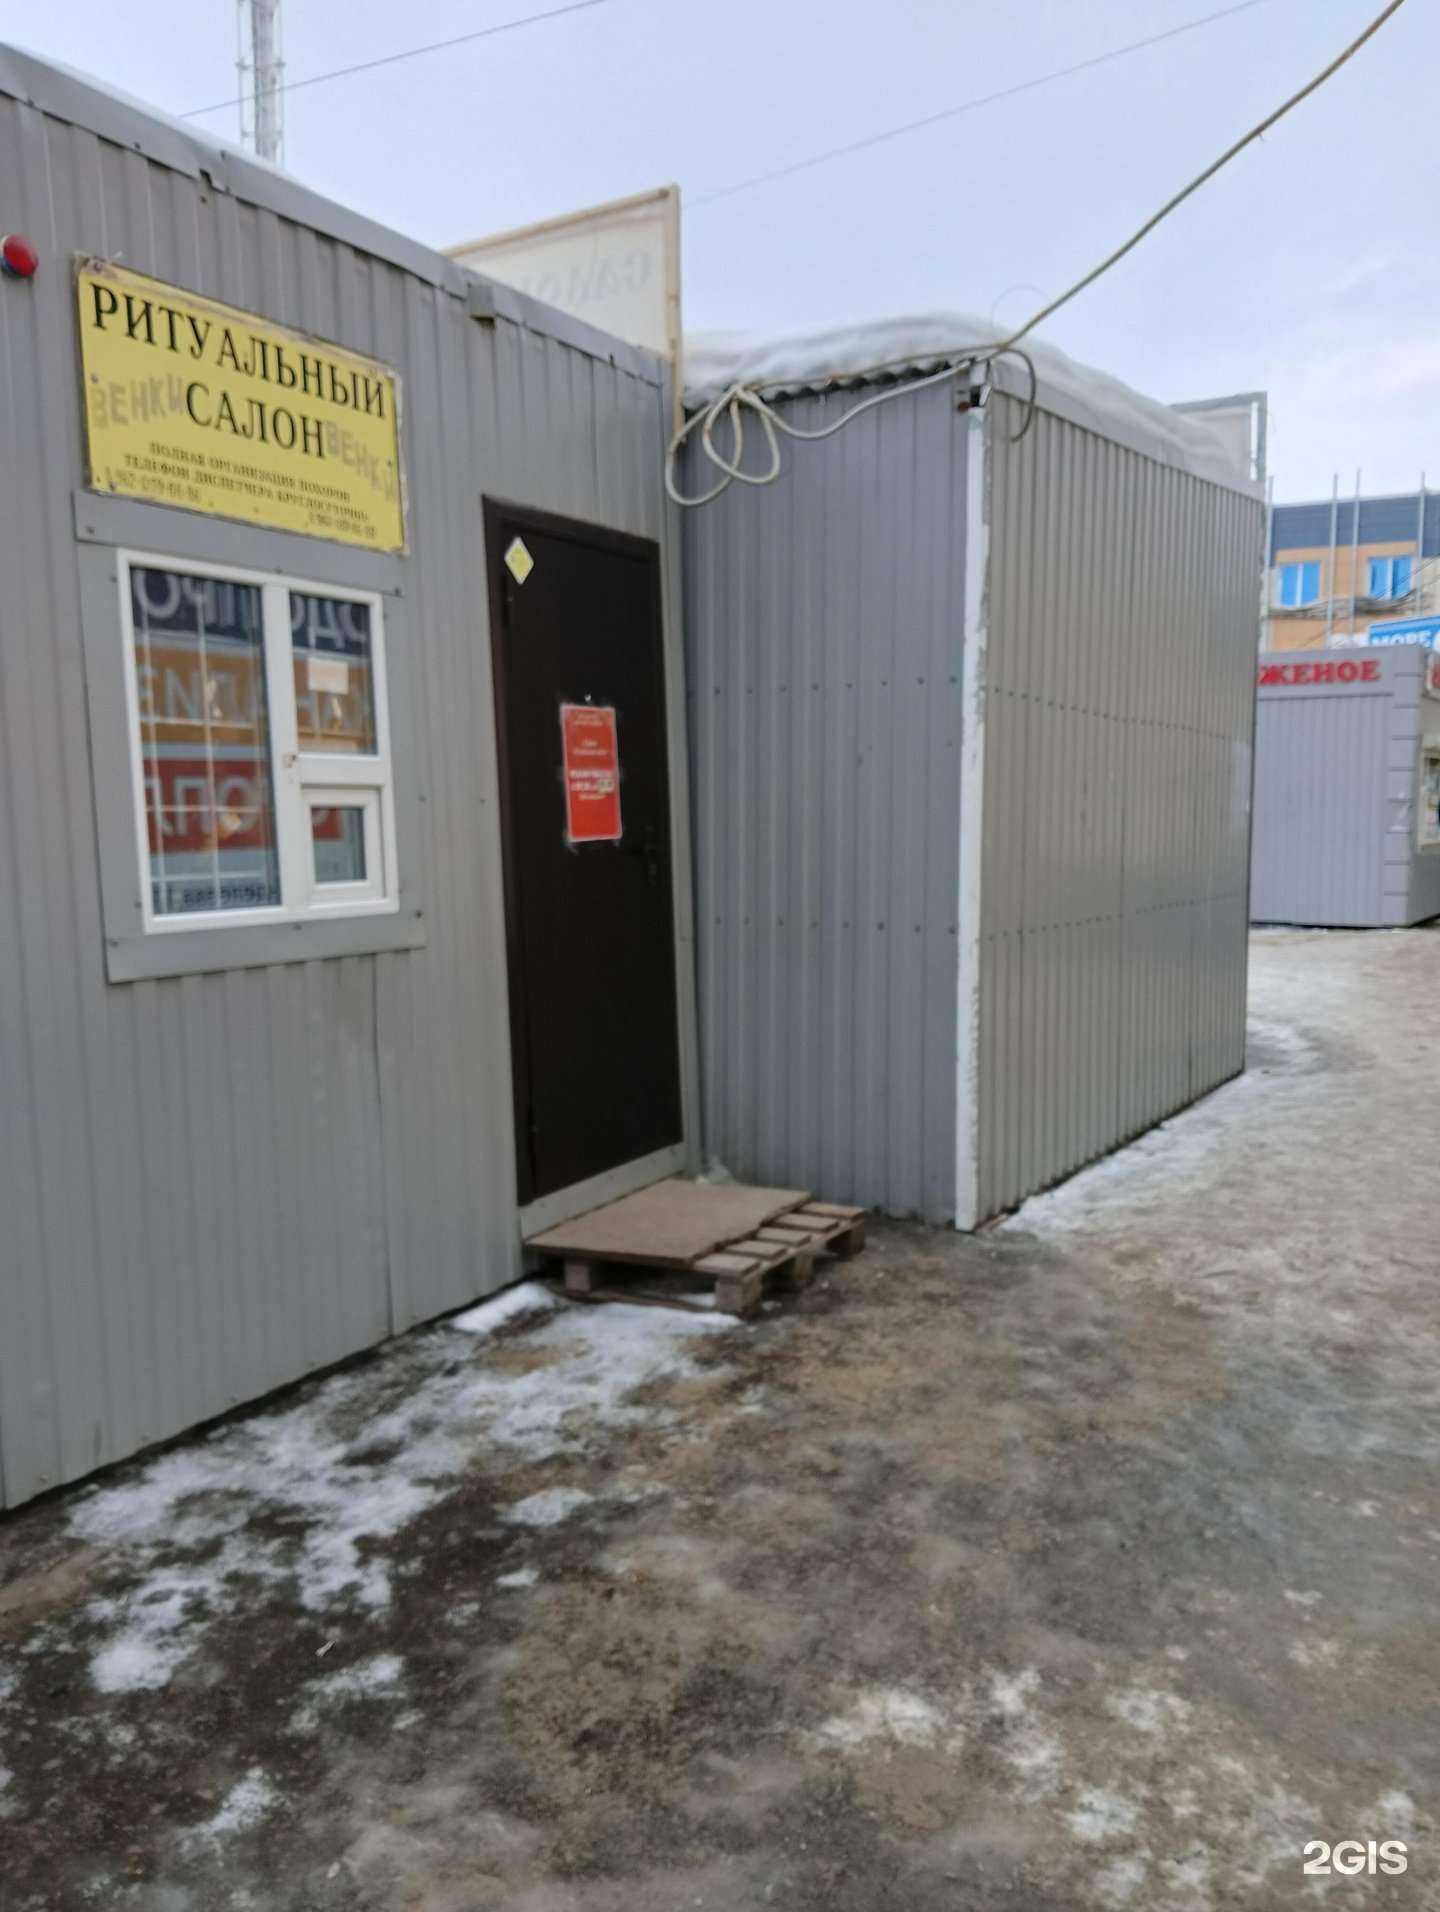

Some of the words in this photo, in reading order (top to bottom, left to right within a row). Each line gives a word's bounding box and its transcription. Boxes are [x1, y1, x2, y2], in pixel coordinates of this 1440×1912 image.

[89, 282, 387, 420] РИТУАЛЬНЫЙ
[91, 373, 185, 430] ВЕНКИ
[185, 381, 326, 459] САЛОН
[1258, 660, 1382, 687] ЖЕНОЕ
